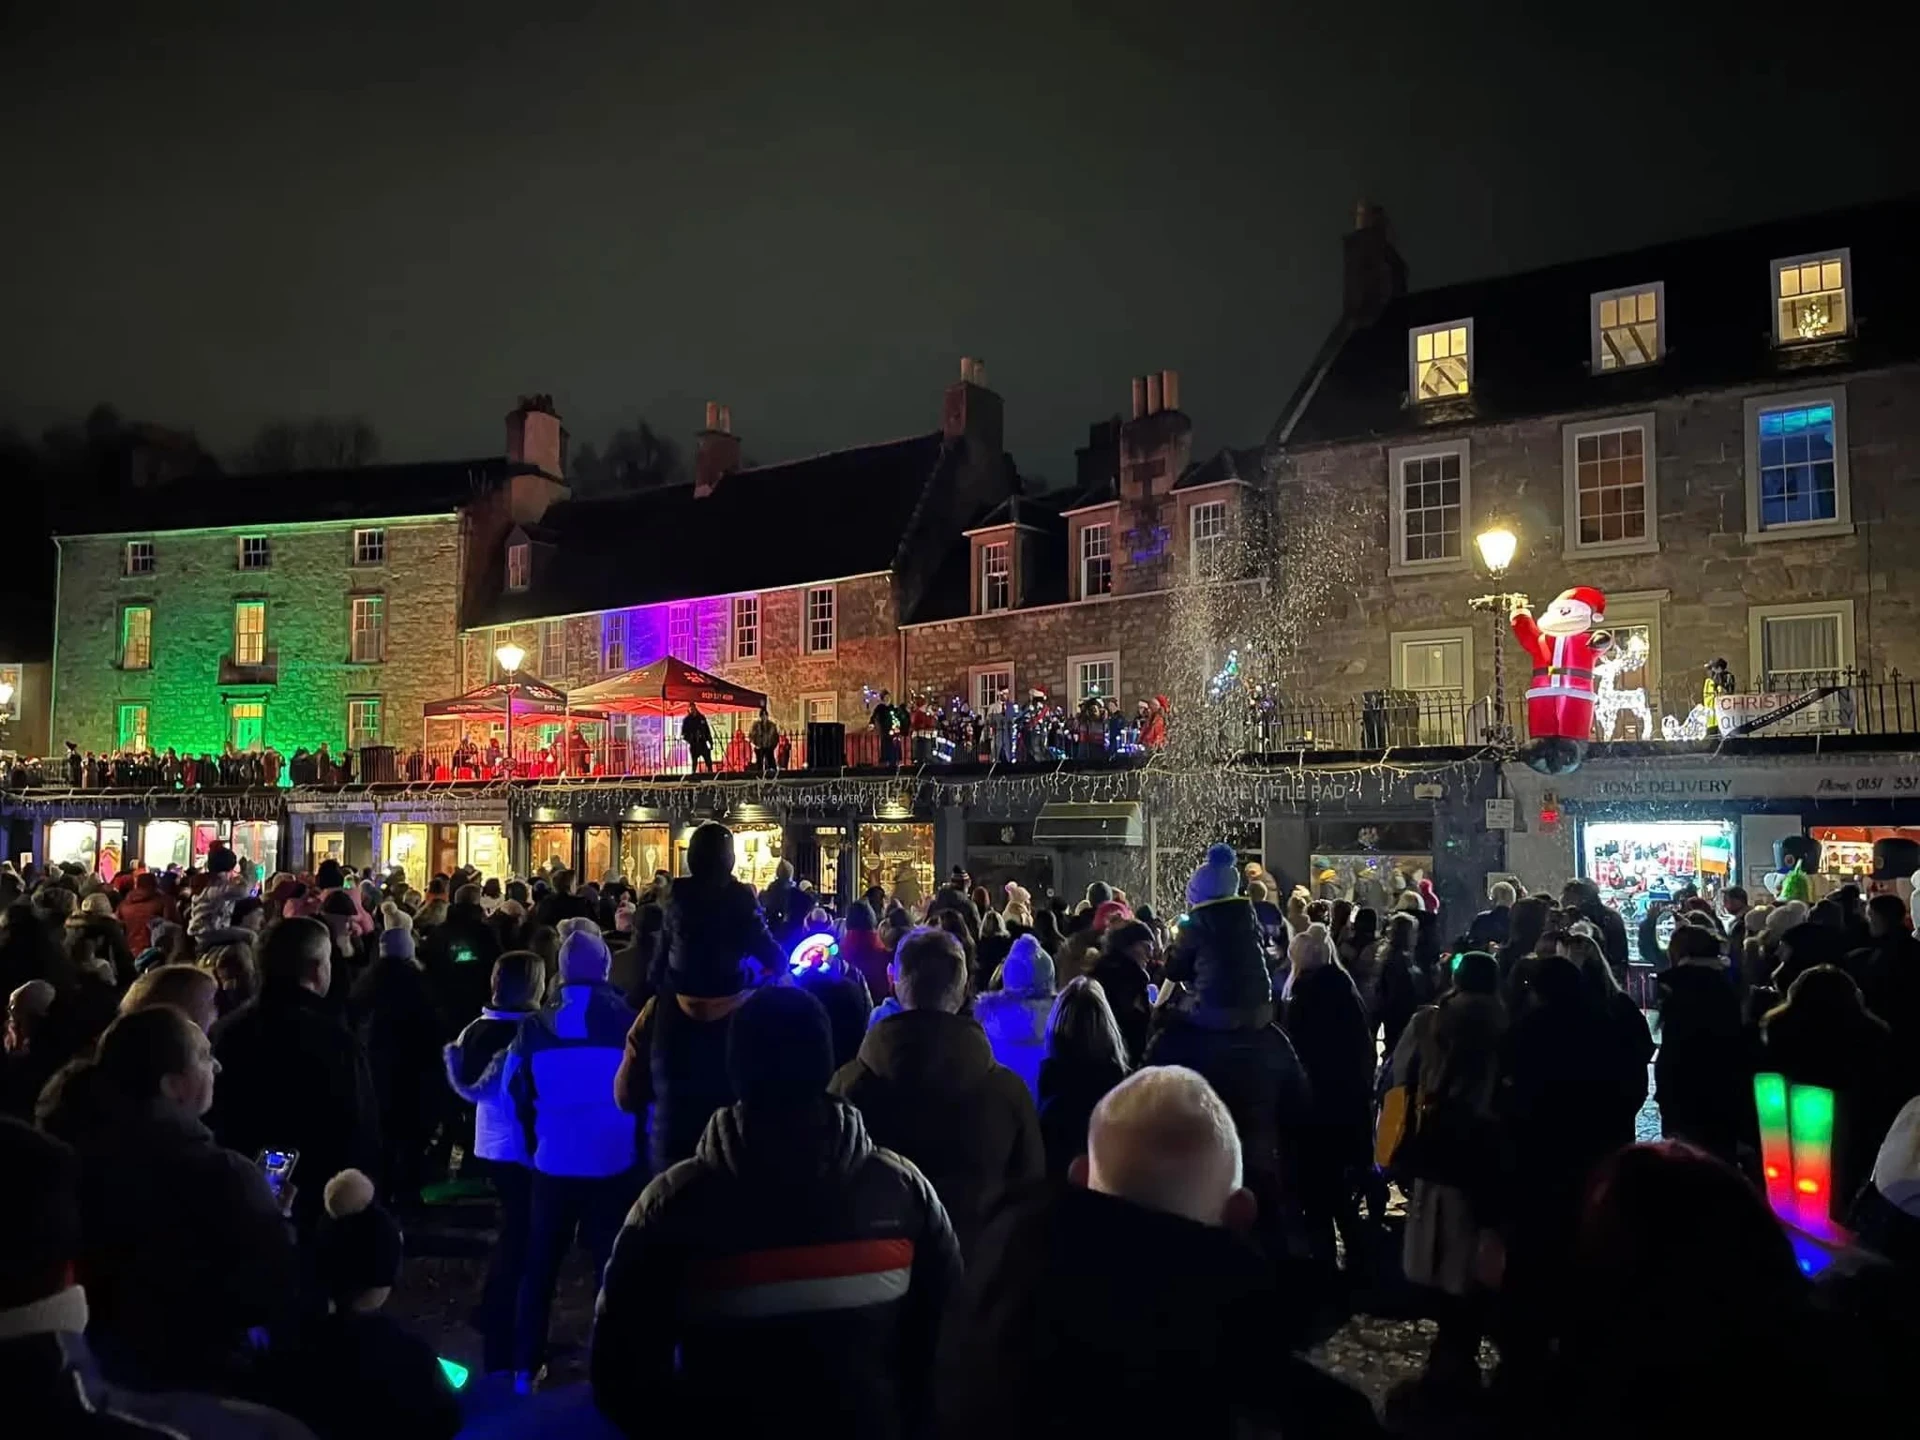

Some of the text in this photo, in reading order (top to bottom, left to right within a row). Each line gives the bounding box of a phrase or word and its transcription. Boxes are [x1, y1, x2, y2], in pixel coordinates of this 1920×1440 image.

[1720, 692, 1824, 711] CHRISTM
[1720, 709, 1854, 730] QUENSFERRY
[1649, 779, 1732, 794] DELIVERY
[798, 794, 826, 806] HOUSE
[831, 793, 865, 806] BAKERY
